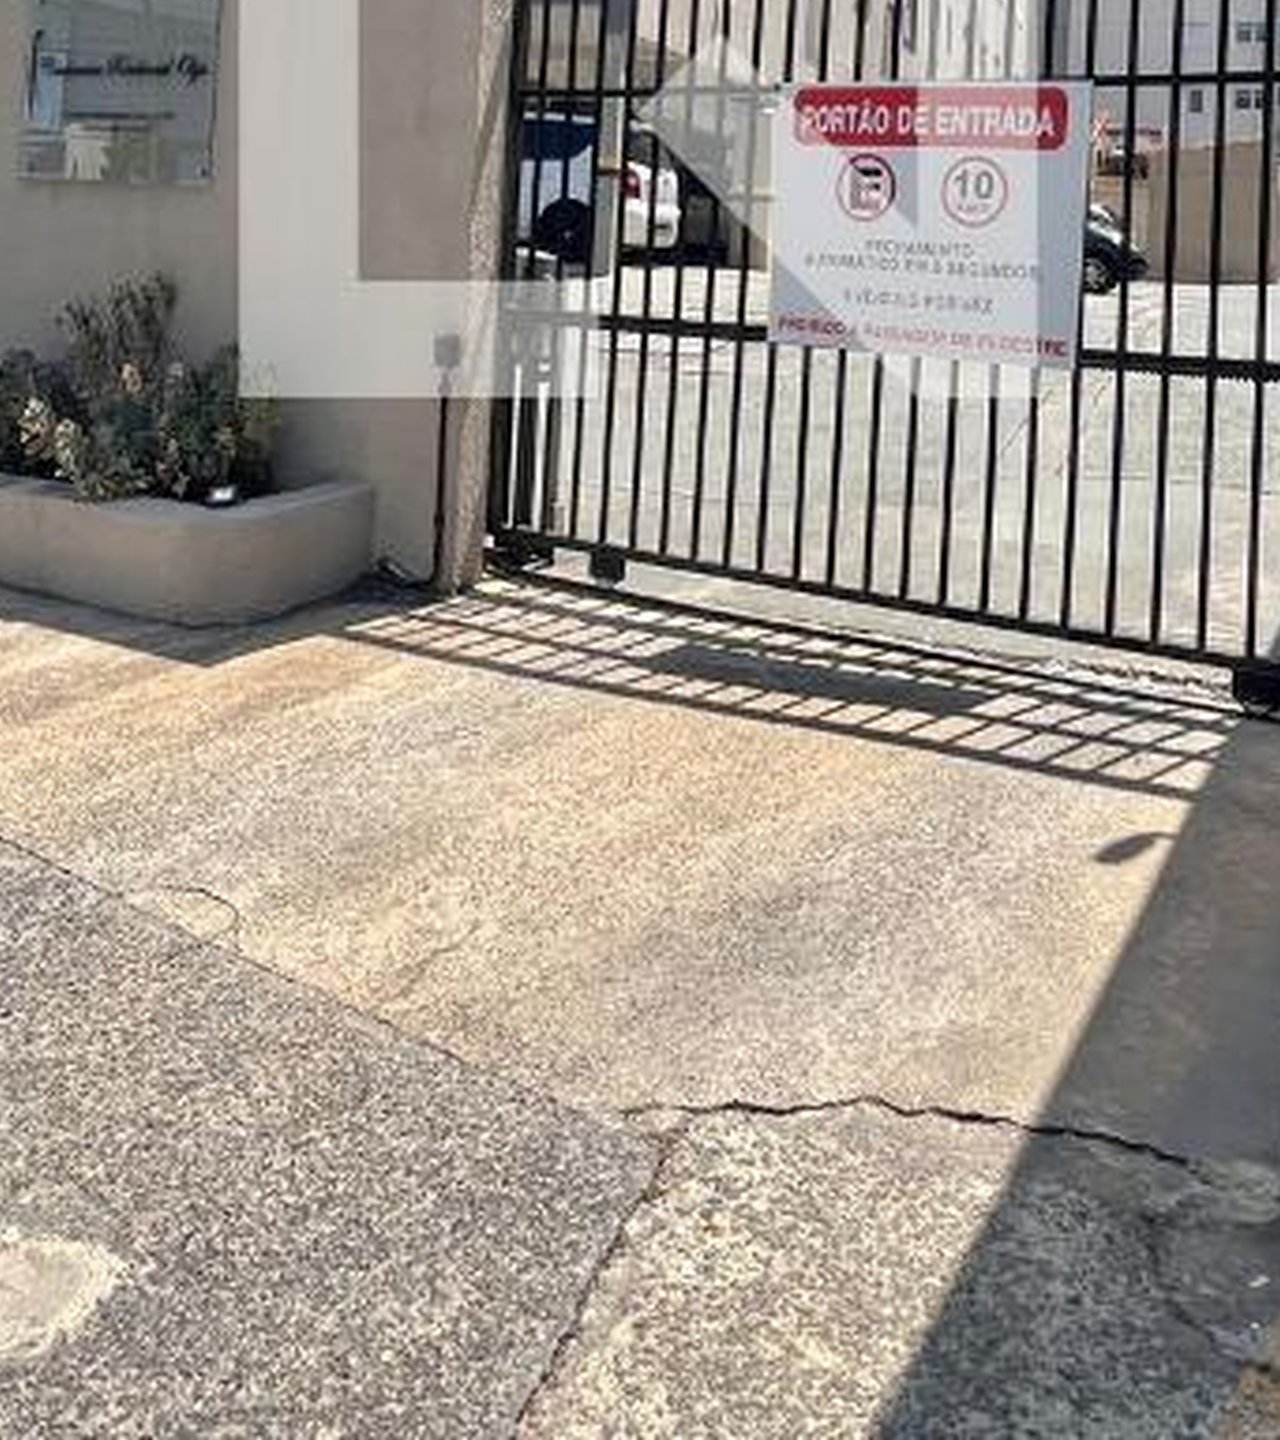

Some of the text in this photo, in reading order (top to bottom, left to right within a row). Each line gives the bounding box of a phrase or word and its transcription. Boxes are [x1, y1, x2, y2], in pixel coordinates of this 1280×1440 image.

[896, 105, 930, 135] DE
[934, 106, 1056, 137] ENTRADA
[953, 168, 994, 200] 10
